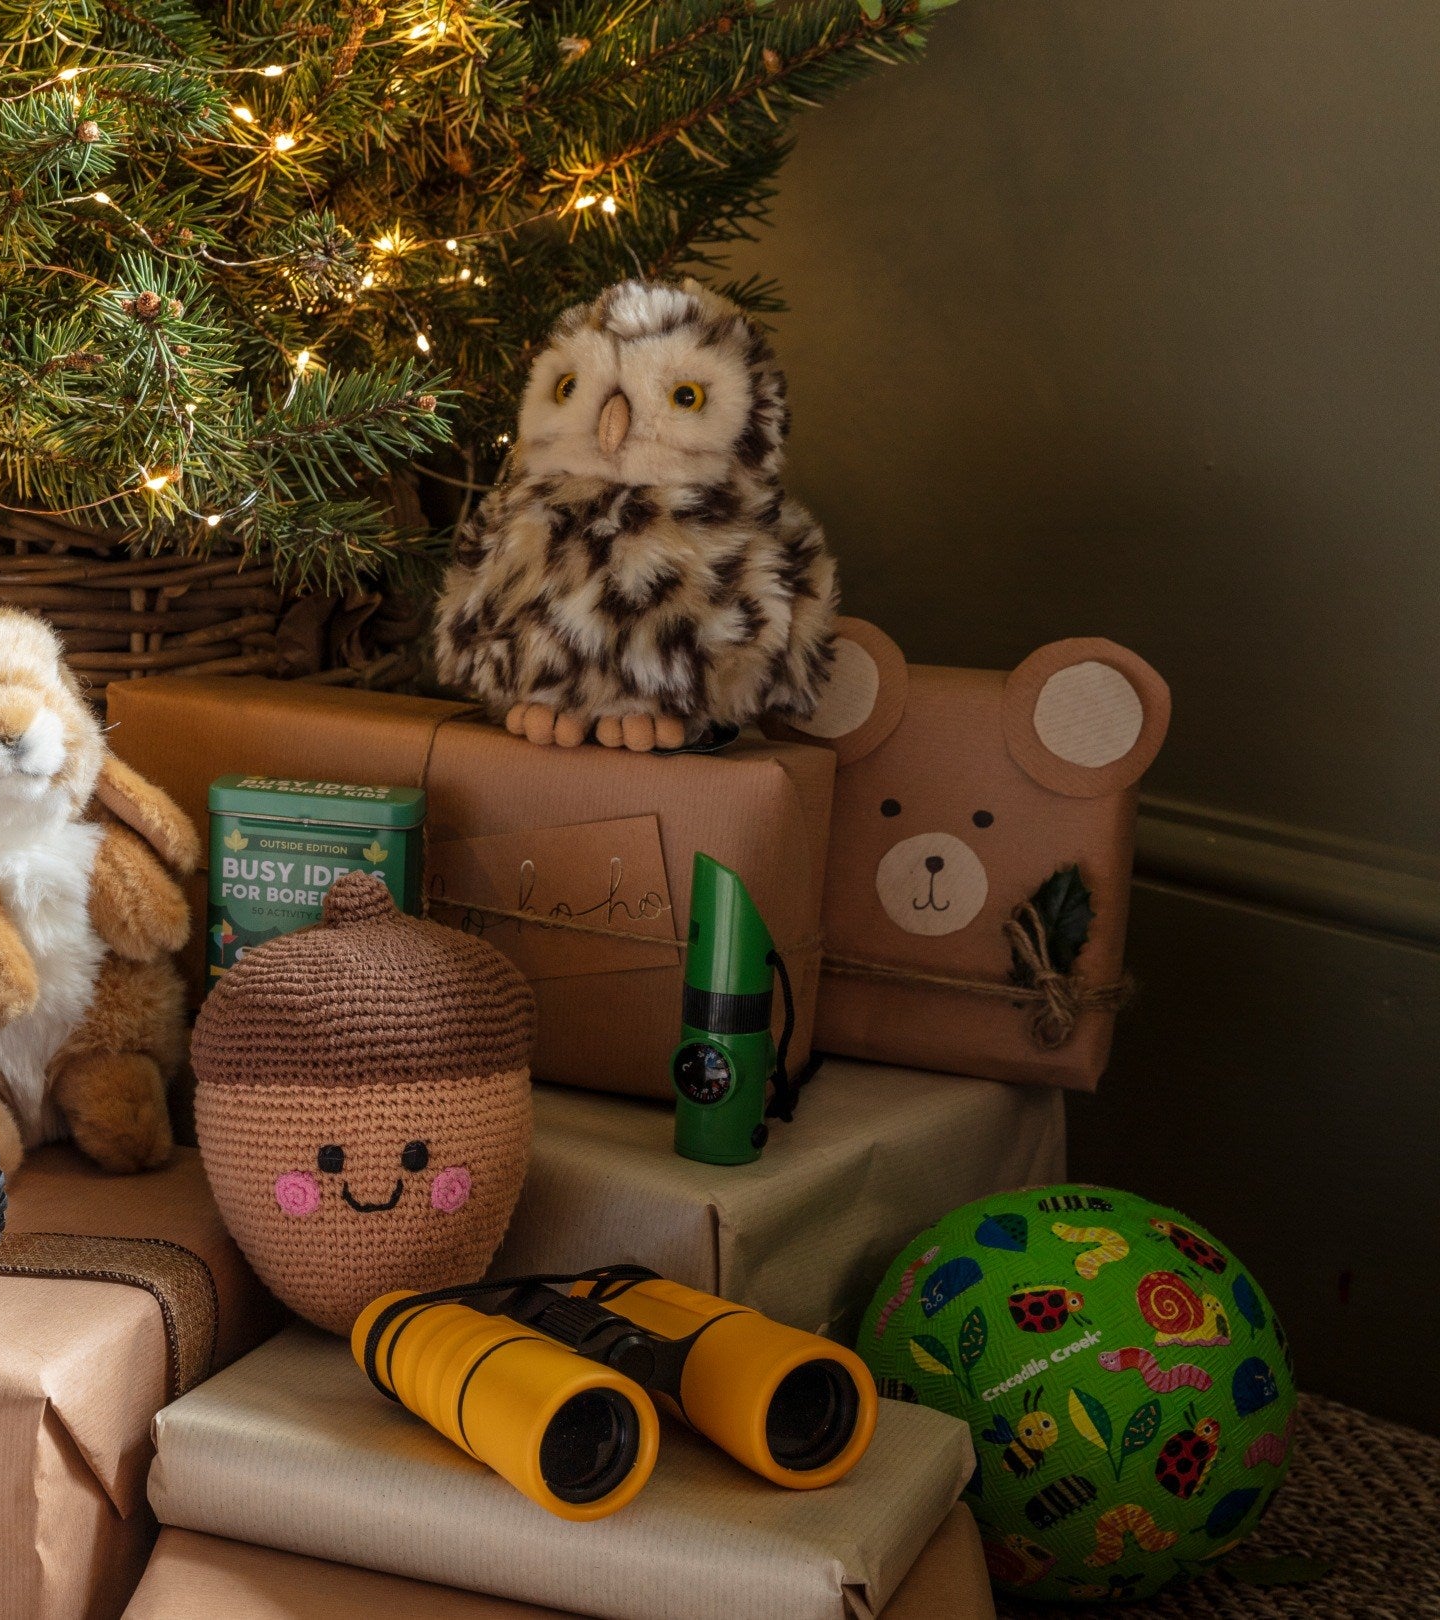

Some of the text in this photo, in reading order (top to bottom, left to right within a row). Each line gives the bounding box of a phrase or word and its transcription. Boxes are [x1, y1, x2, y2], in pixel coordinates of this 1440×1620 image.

[240, 779, 391, 794] BUSY IDEAS
[277, 786, 340, 795] BORED
[344, 791, 386, 799] KIDS
[260, 839, 348, 855] OUTSIDE EDITION
[222, 857, 386, 887] BUSY IDES
[222, 882, 261, 901] FOR
[252, 907, 264, 916] 50
[267, 908, 313, 919] ACTIVITY
[982, 1358, 1049, 1402] Crocodile
